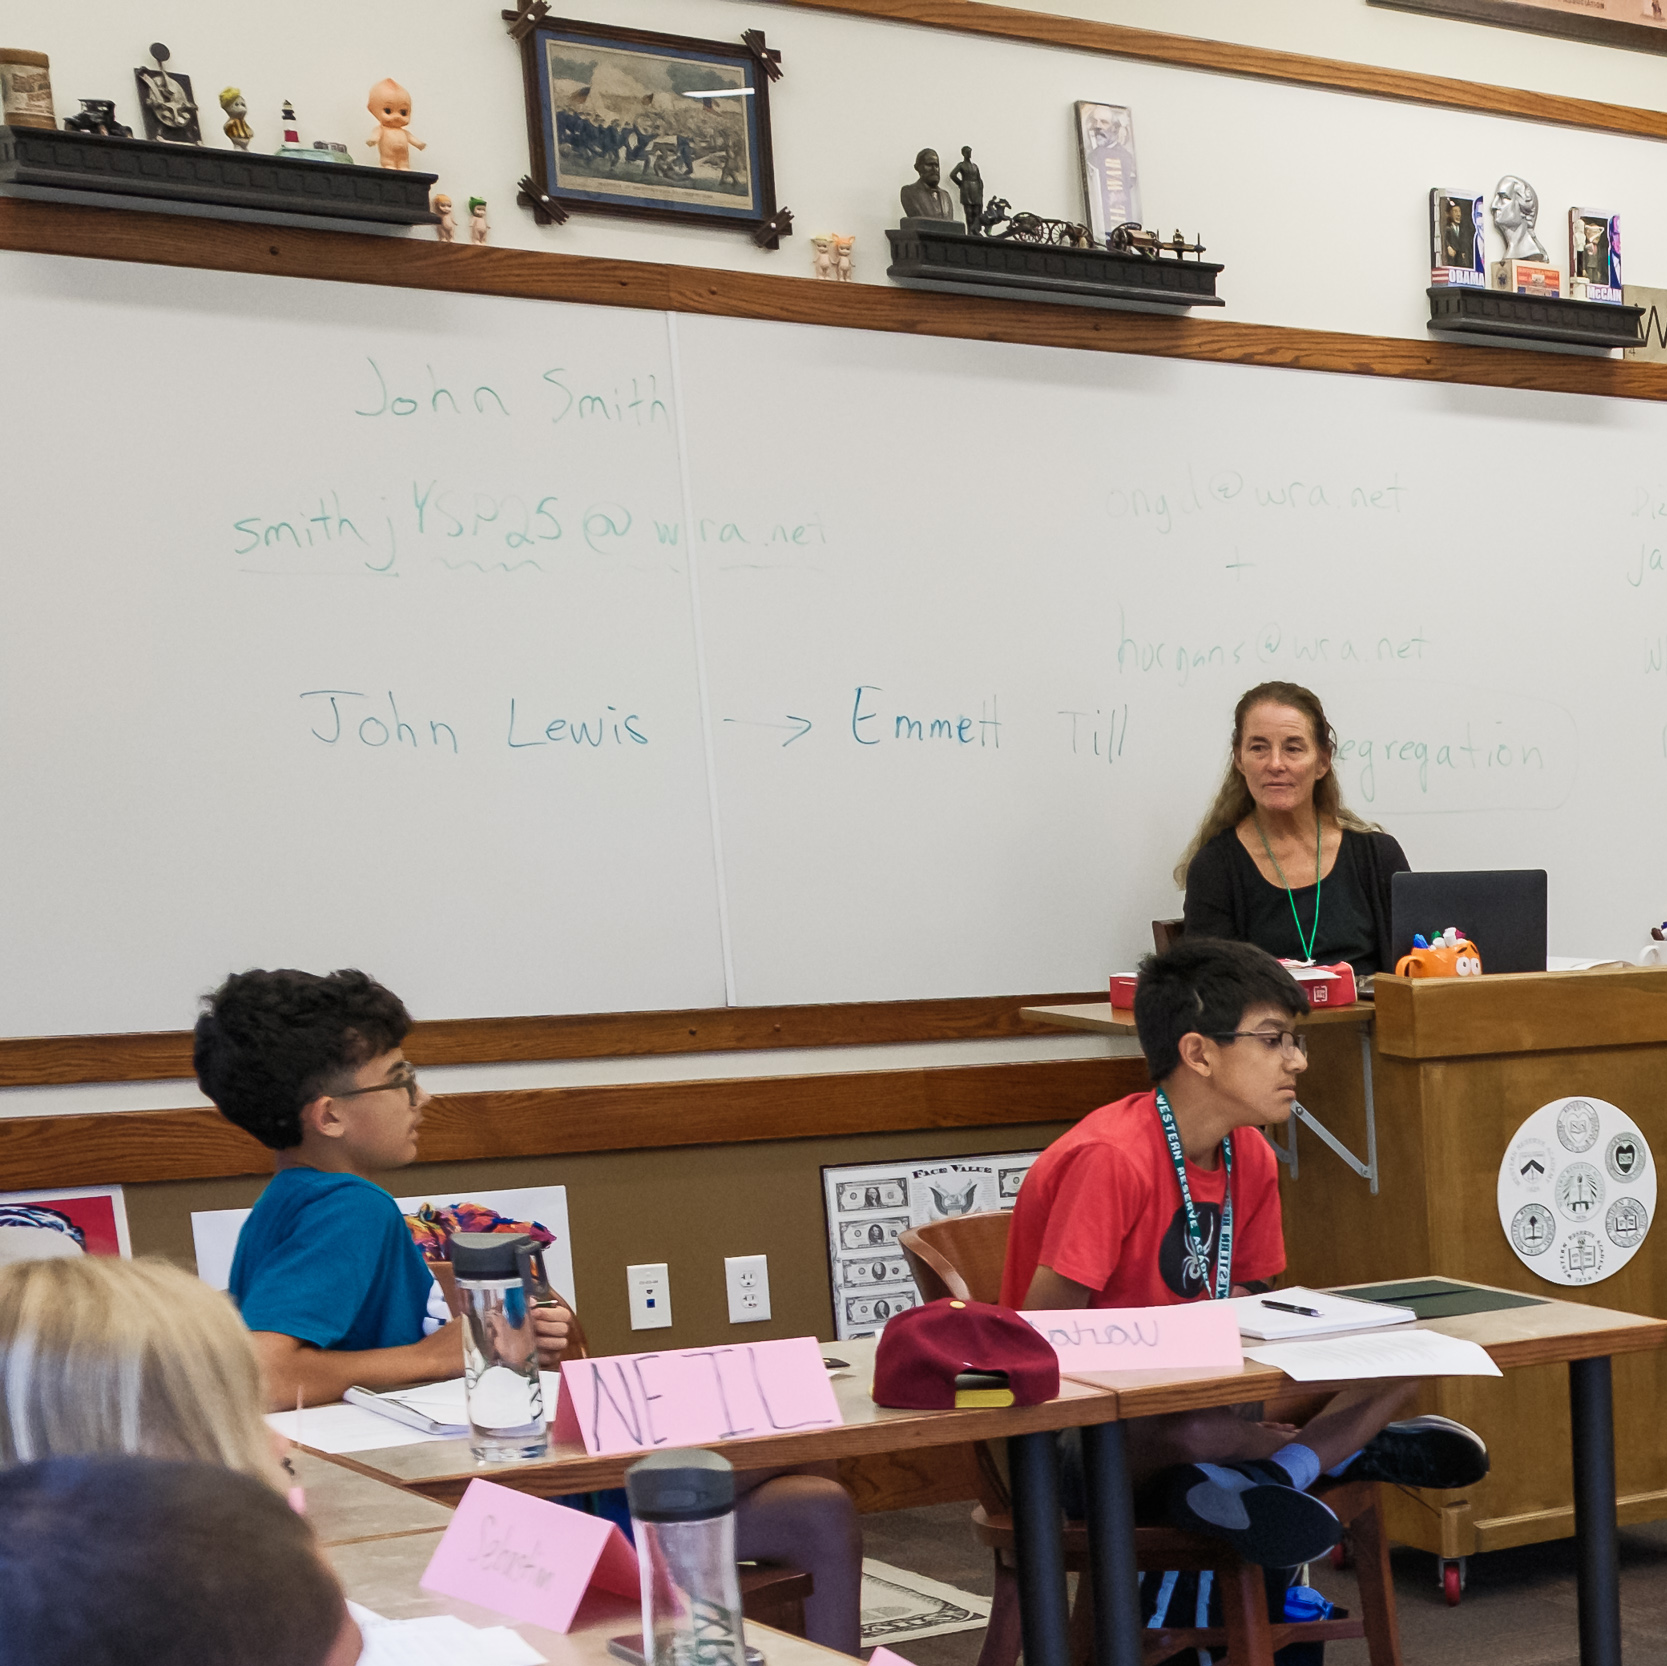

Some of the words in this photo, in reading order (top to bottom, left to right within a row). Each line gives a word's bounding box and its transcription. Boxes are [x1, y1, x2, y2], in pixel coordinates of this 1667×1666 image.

[1448, 268, 1486, 287] OBAMA
[355, 357, 510, 417] John
[542, 367, 668, 427] Smith
[300, 690, 458, 754] John
[508, 697, 650, 749] Lewis
[852, 685, 1003, 749] Emmett
[1058, 703, 1131, 766] Till
[1335, 720, 1544, 801] egregation
[912, 1165, 948, 1179] FACE
[951, 1164, 992, 1175] VALUE
[1156, 1093, 1184, 1161] WESTERN
[1176, 1166, 1199, 1229] RESERVE
[591, 1346, 834, 1450] NEIL
